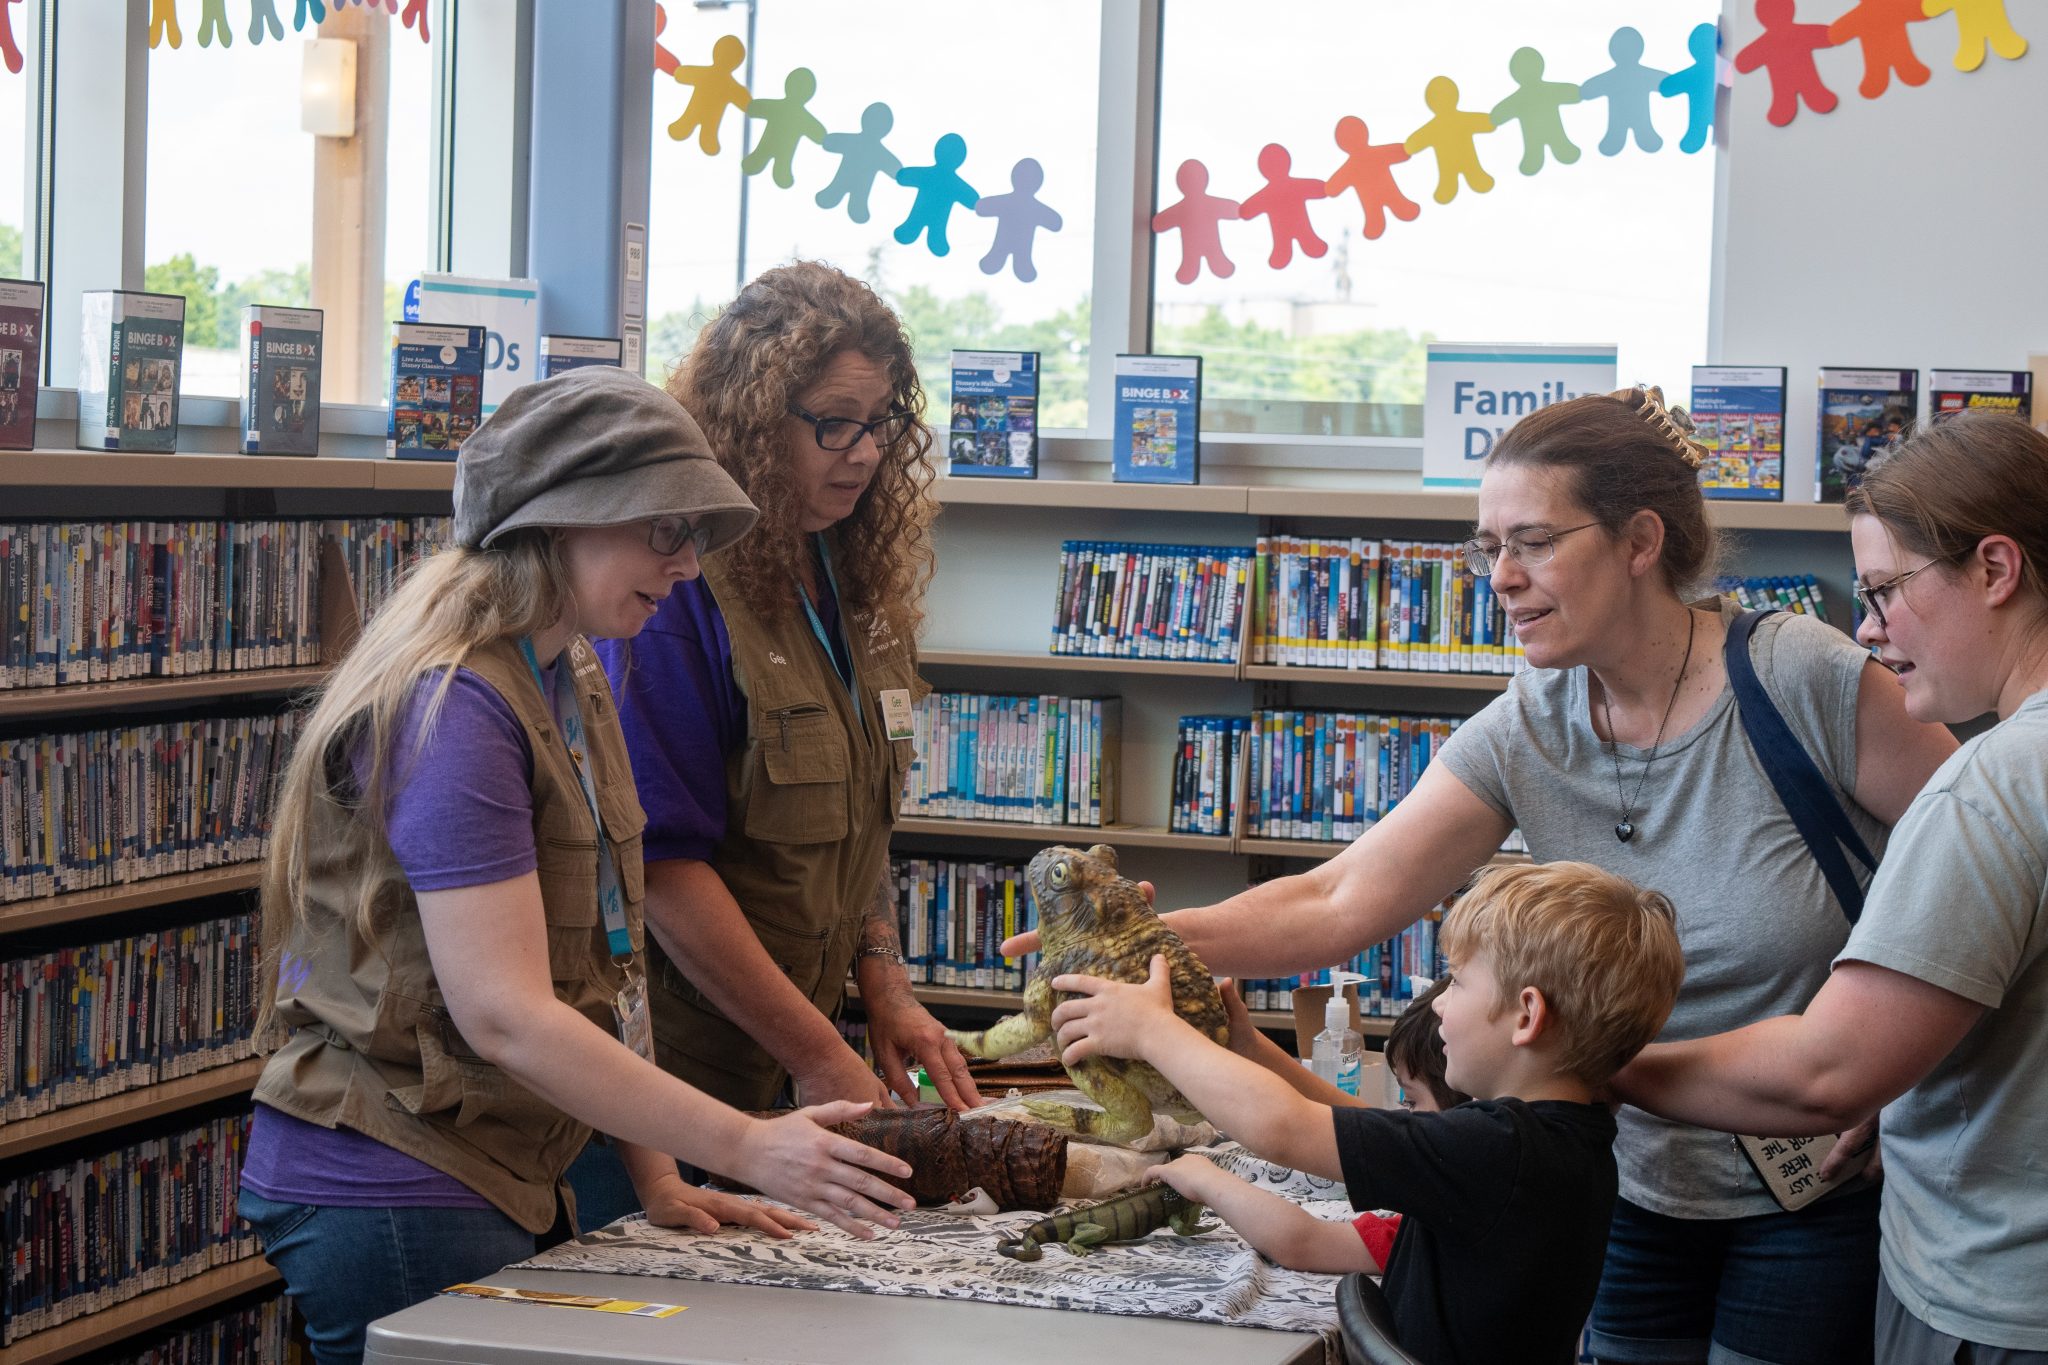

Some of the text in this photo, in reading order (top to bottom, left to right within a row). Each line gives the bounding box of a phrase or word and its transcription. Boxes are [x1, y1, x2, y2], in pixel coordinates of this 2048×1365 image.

[112, 330, 121, 351] BINGE
[127, 331, 156, 346] BINGE
[252, 340, 260, 358] BINGE
[266, 342, 295, 355] BINGE
[1122, 387, 1160, 400] BINGE
[1453, 381, 1576, 416] Famil
[1940, 398, 1963, 408] LEGO
[20, 574, 29, 602] lyrics
[769, 651, 787, 665] Gee
[240, 768, 251, 831] PARKLAND
[117, 975, 125, 1040] POLTERGEIST
[1760, 1140, 1788, 1161] THE
[1777, 1152, 1813, 1179] HERE
[1789, 1173, 1814, 1196] JUST
